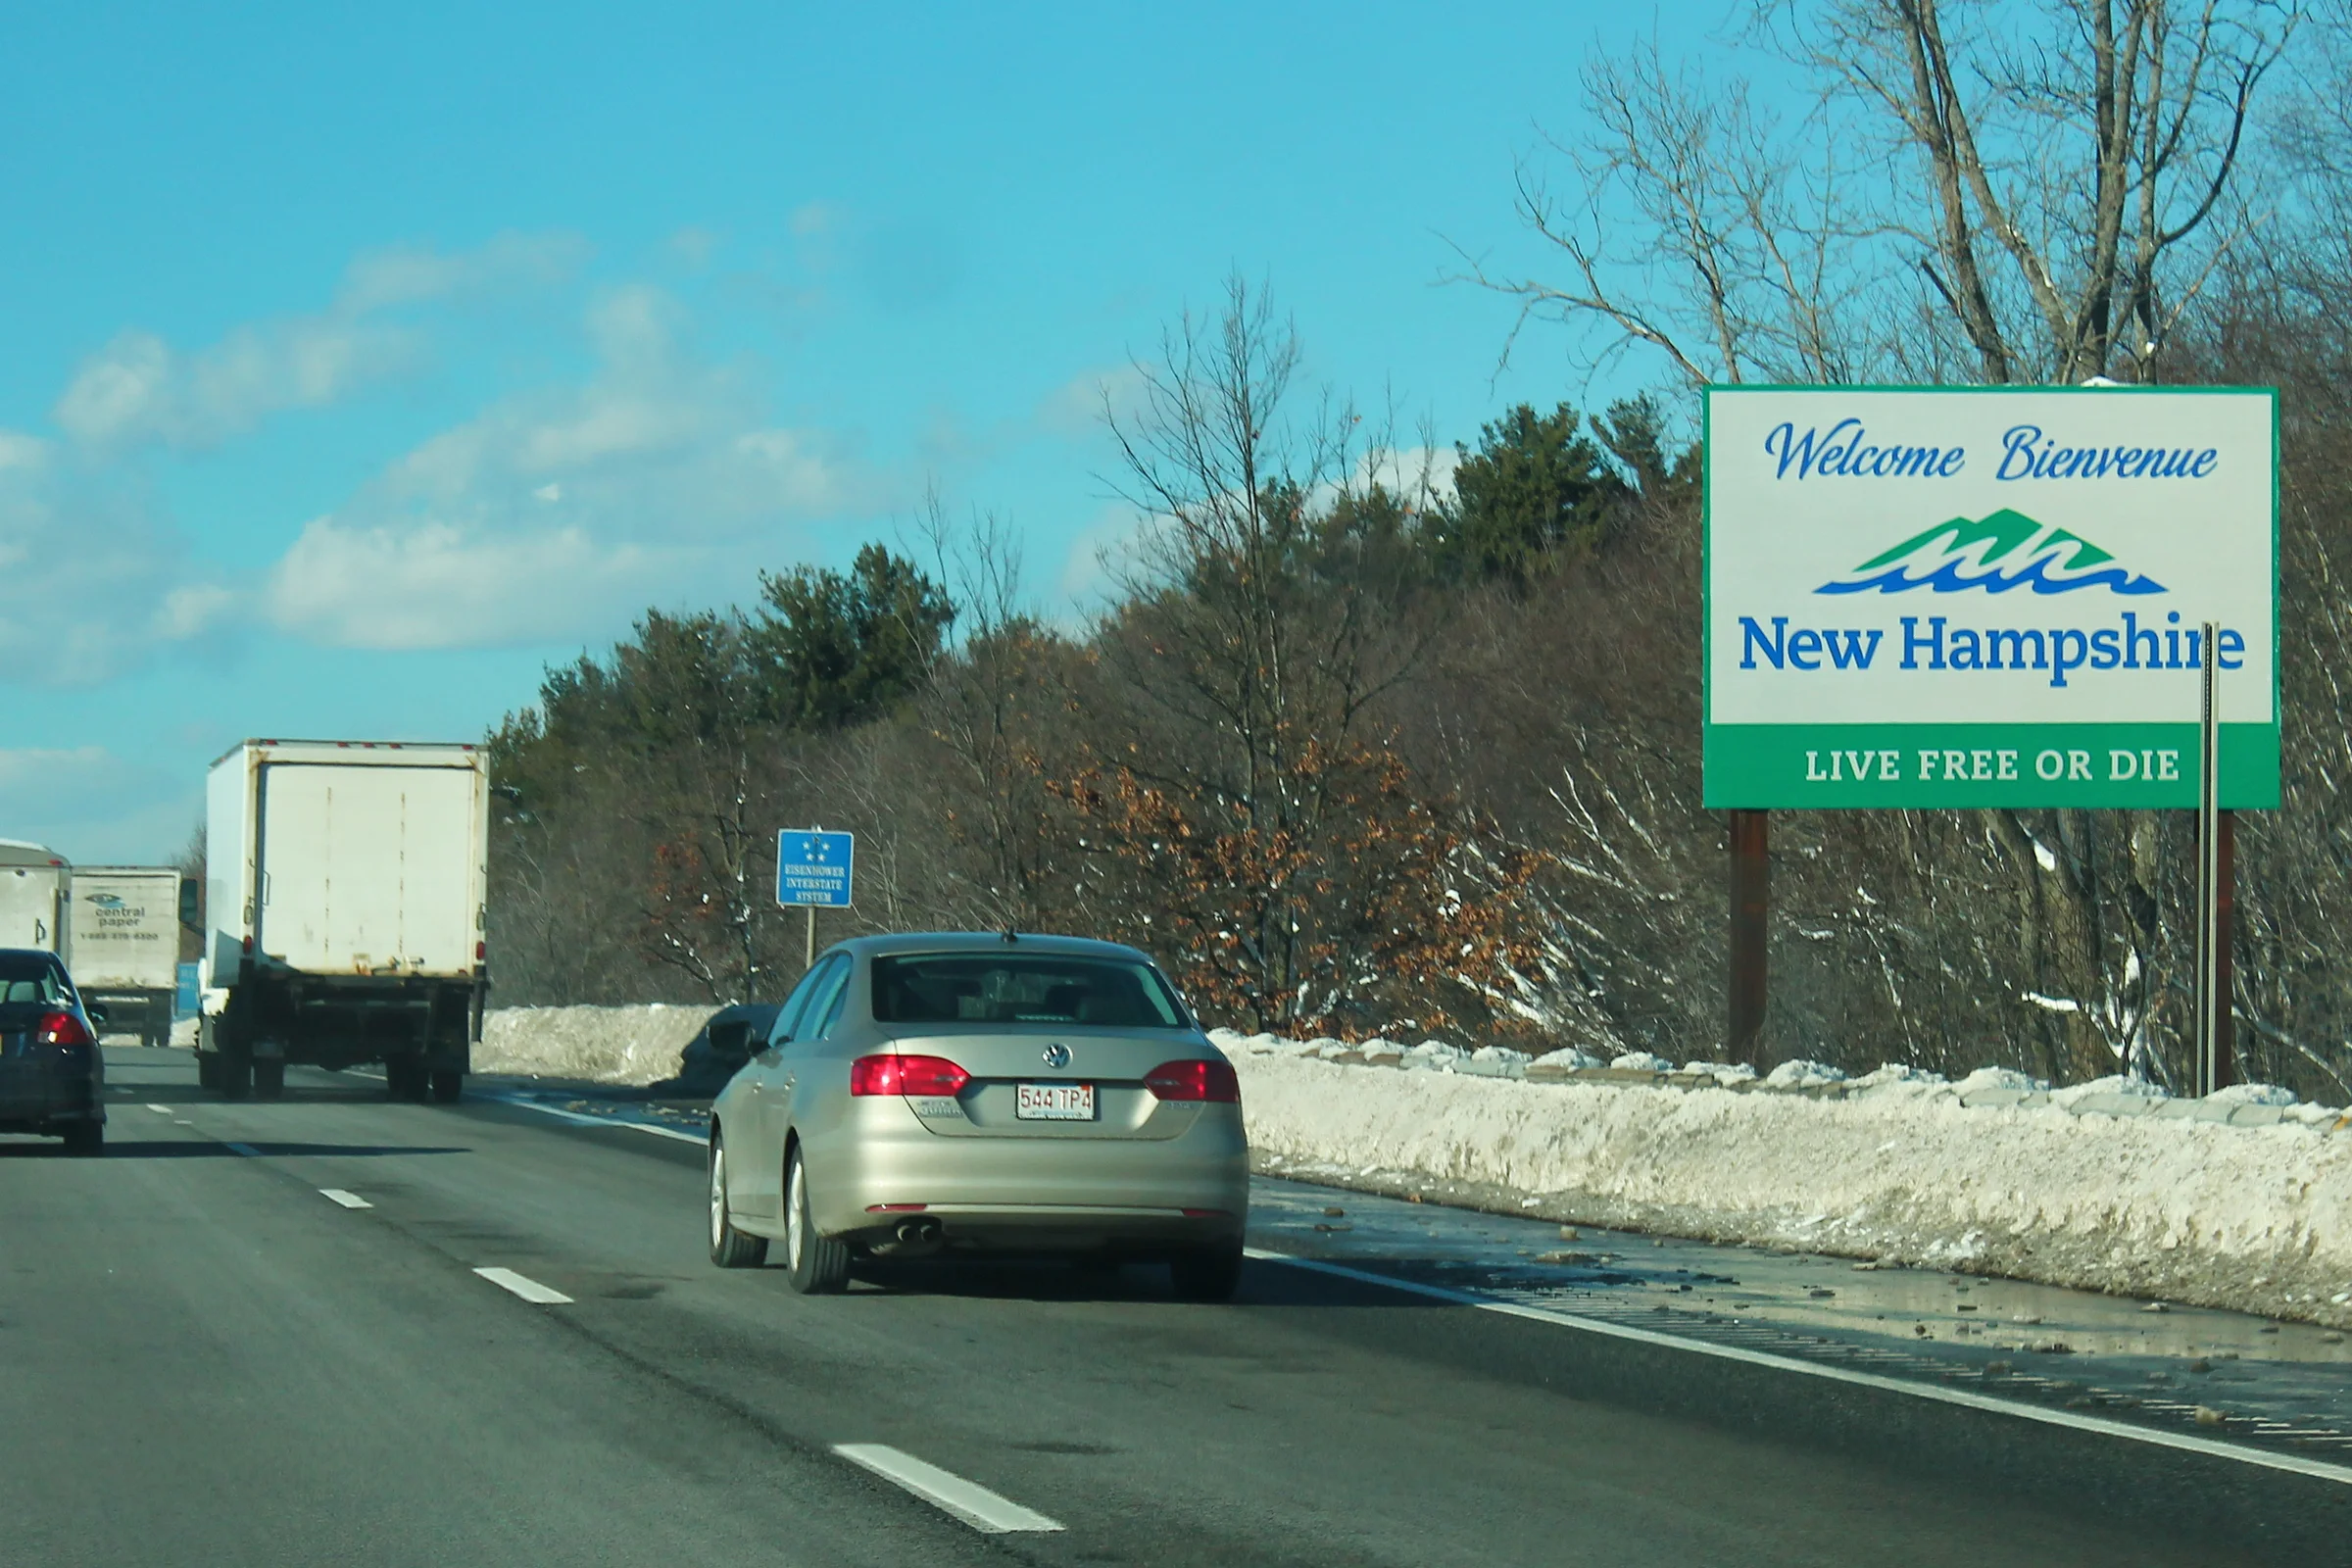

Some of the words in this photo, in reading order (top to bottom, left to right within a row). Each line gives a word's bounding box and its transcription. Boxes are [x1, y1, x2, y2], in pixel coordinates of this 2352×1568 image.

[1764, 418, 1965, 480] Welcome
[1996, 424, 2218, 481] Bienvenue
[1738, 616, 1884, 670] New
[1899, 612, 2245, 688] Hampshire
[1805, 751, 1900, 781] LIVE
[1918, 751, 2018, 781] FREE
[2035, 750, 2093, 780] OR
[2109, 750, 2180, 780] DIE
[785, 864, 845, 877] EISENHOWER
[786, 878, 842, 890] INTERSTATE
[796, 891, 831, 902] SYSTEM
[95, 906, 145, 917] central
[99, 917, 140, 927] paper
[1020, 1088, 1053, 1109] 544
[1057, 1088, 1092, 1110] TP4
